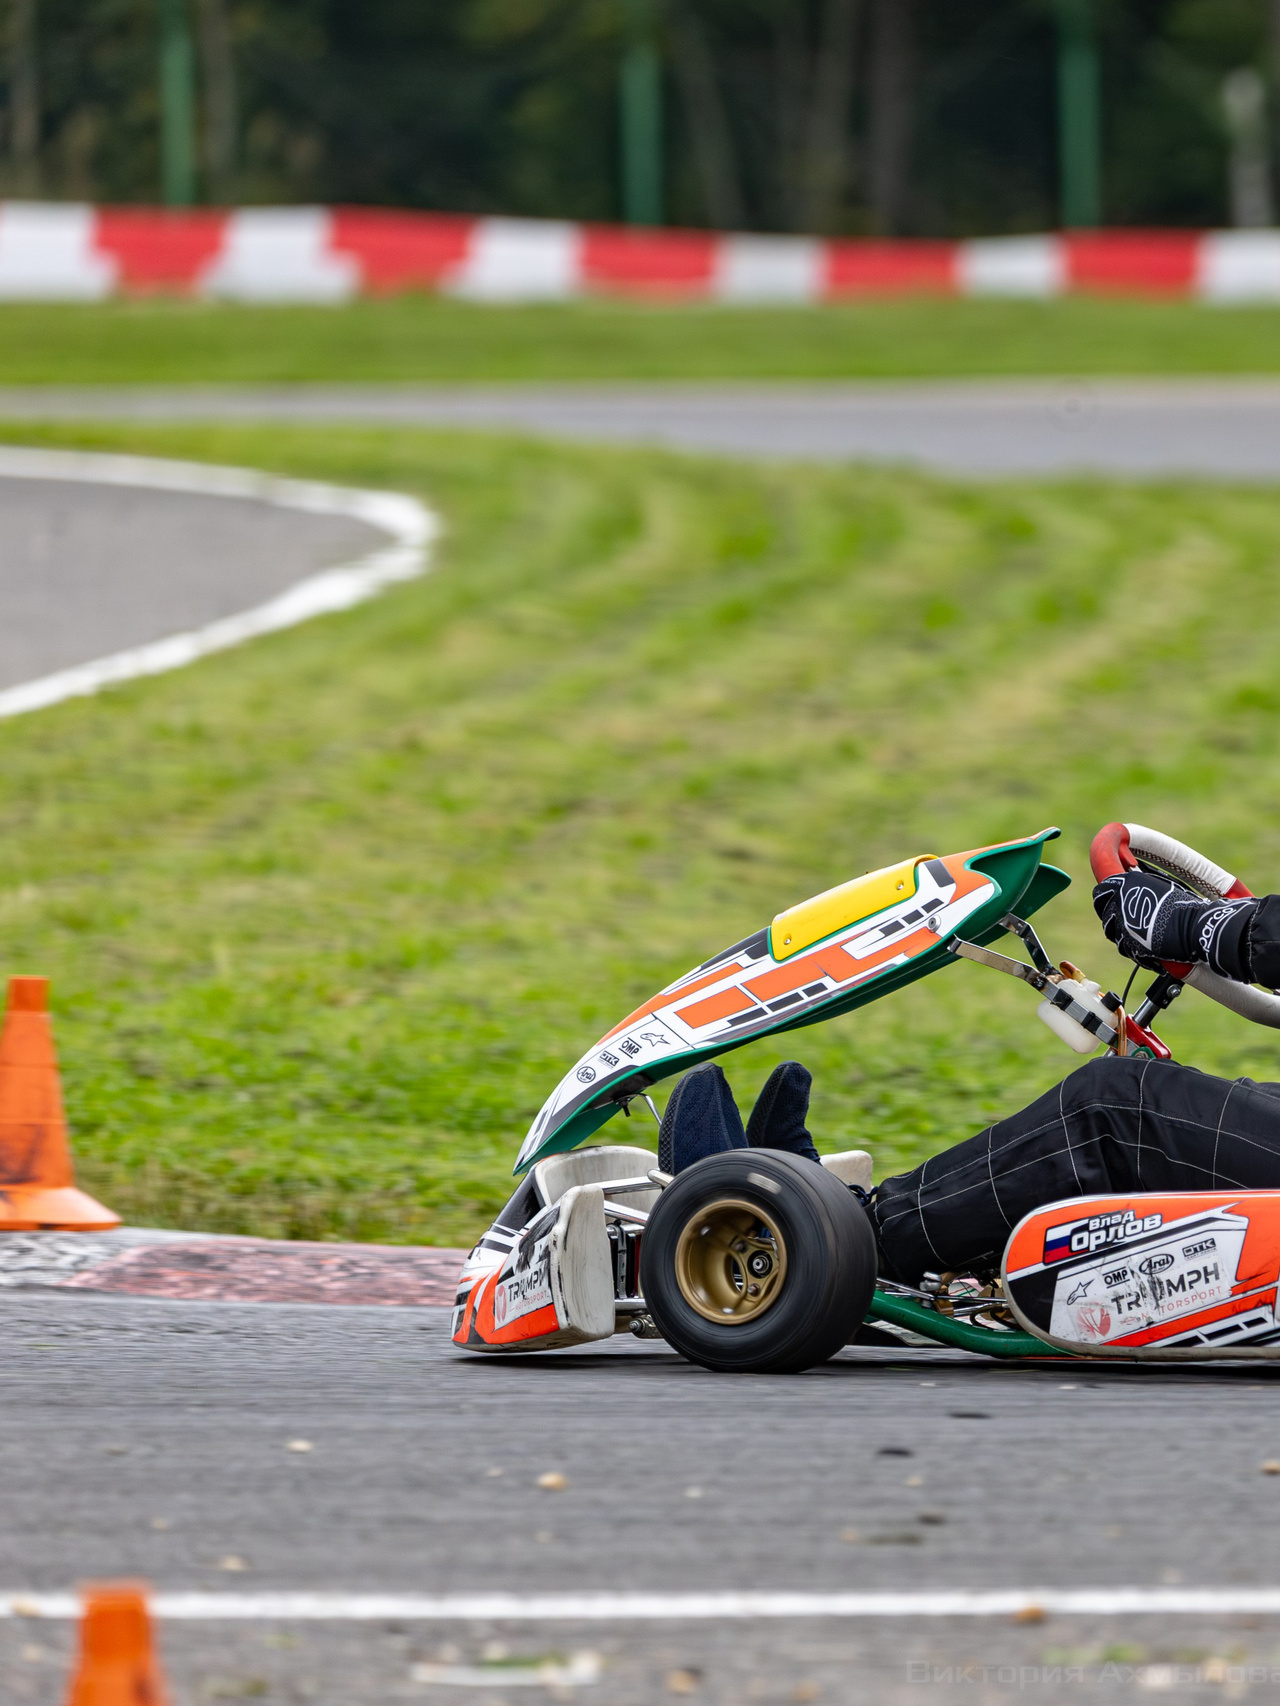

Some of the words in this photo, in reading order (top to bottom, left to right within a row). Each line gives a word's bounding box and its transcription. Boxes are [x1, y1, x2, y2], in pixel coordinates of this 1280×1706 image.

[1199, 906, 1236, 953] parco
[621, 1040, 640, 1055] OMP
[1182, 1239, 1216, 1257] OTK
[1146, 1256, 1170, 1270] Arai
[1104, 1269, 1128, 1286] OMP
[1111, 1262, 1220, 1315] TRMPH
